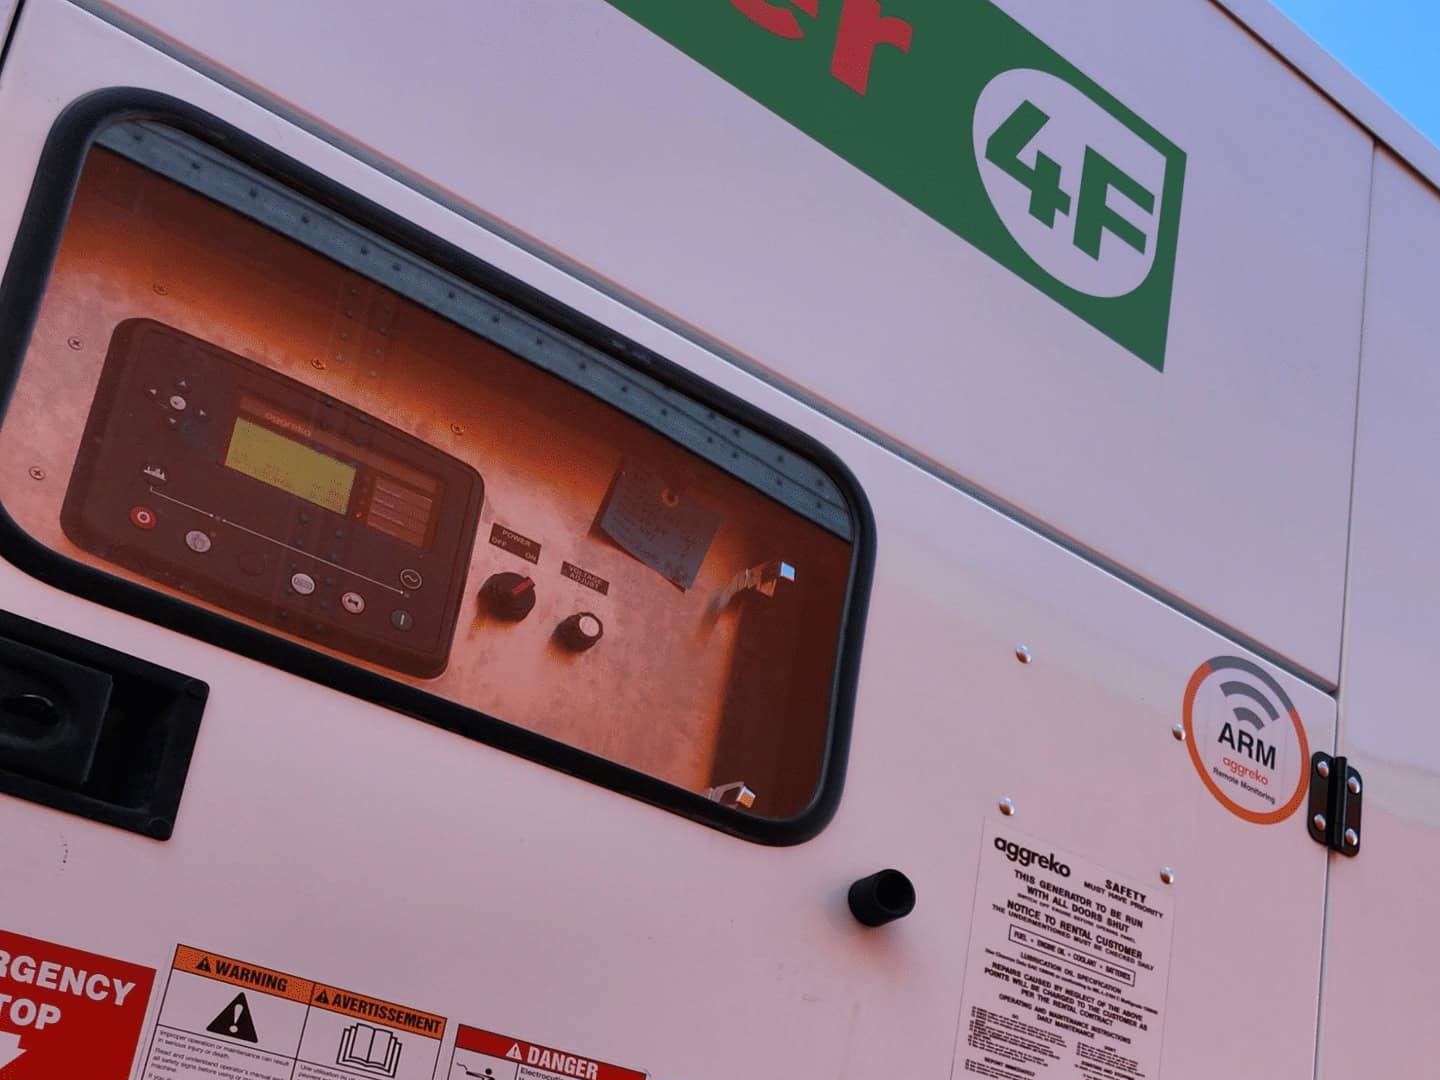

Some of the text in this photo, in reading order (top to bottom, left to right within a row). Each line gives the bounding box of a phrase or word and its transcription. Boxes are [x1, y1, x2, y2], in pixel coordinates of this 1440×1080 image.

[985, 100, 1155, 262] 4F
[1217, 722, 1276, 771] ARM
[1212, 767, 1276, 805] Remote Monitoring
[1222, 757, 1269, 785] aggreko
[994, 837, 1070, 877] aggreko
[1014, 869, 1143, 928] THIS GENERATOR TO BE RUN
[1027, 885, 1129, 932] WITH ALL DOORS SHUT
[1083, 881, 1163, 918] MUST HAVE PRIORITY
[1105, 879, 1146, 903] SAFETY
[992, 903, 1154, 971] THE UNDERMENTIONED MUST BE CHECKED DAILY
[1007, 900, 1142, 959] NOTICE TO RENTAL CUSTOMER
[1014, 931, 1130, 980] FUEL ENGINE OIL COOLANT BATTERIES
[1020, 952, 1061, 971] LUBRICATION
[1064, 968, 1074, 977] OIL
[1077, 973, 1121, 993] SPECIFICATION
[215, 960, 289, 993] WARNING
[992, 962, 1021, 977] REPAIRS
[1023, 974, 1051, 988] CAUSED
[1054, 984, 1063, 992] BY
[1065, 988, 1095, 1003] NEGLECT
[1096, 999, 1106, 1007] OF
[1108, 1003, 1120, 1013] THE
[1122, 1009, 1142, 1021] ABOVE
[332, 993, 442, 1034] AVERTISSEMENT
[984, 967, 1009, 981] POINTS
[1012, 977, 1028, 988] WILL
[1030, 983, 1039, 992] BE
[1042, 988, 1074, 1004] CHARGED
[1077, 1000, 1085, 1008] TO
[1088, 1004, 1100, 1014] THE
[1102, 1010, 1137, 1026] CUSTOMER
[1139, 1023, 1147, 1031] AS
[999, 993, 1131, 1044] OPERATING AND MAINTENANCE INSTRUCTIONS
[1021, 988, 1113, 1025] PER THE RENTAL CONTRACT
[1037, 1014, 1094, 1038] DAILY MAINTENANCE
[527, 1045, 599, 1080] DANGER
